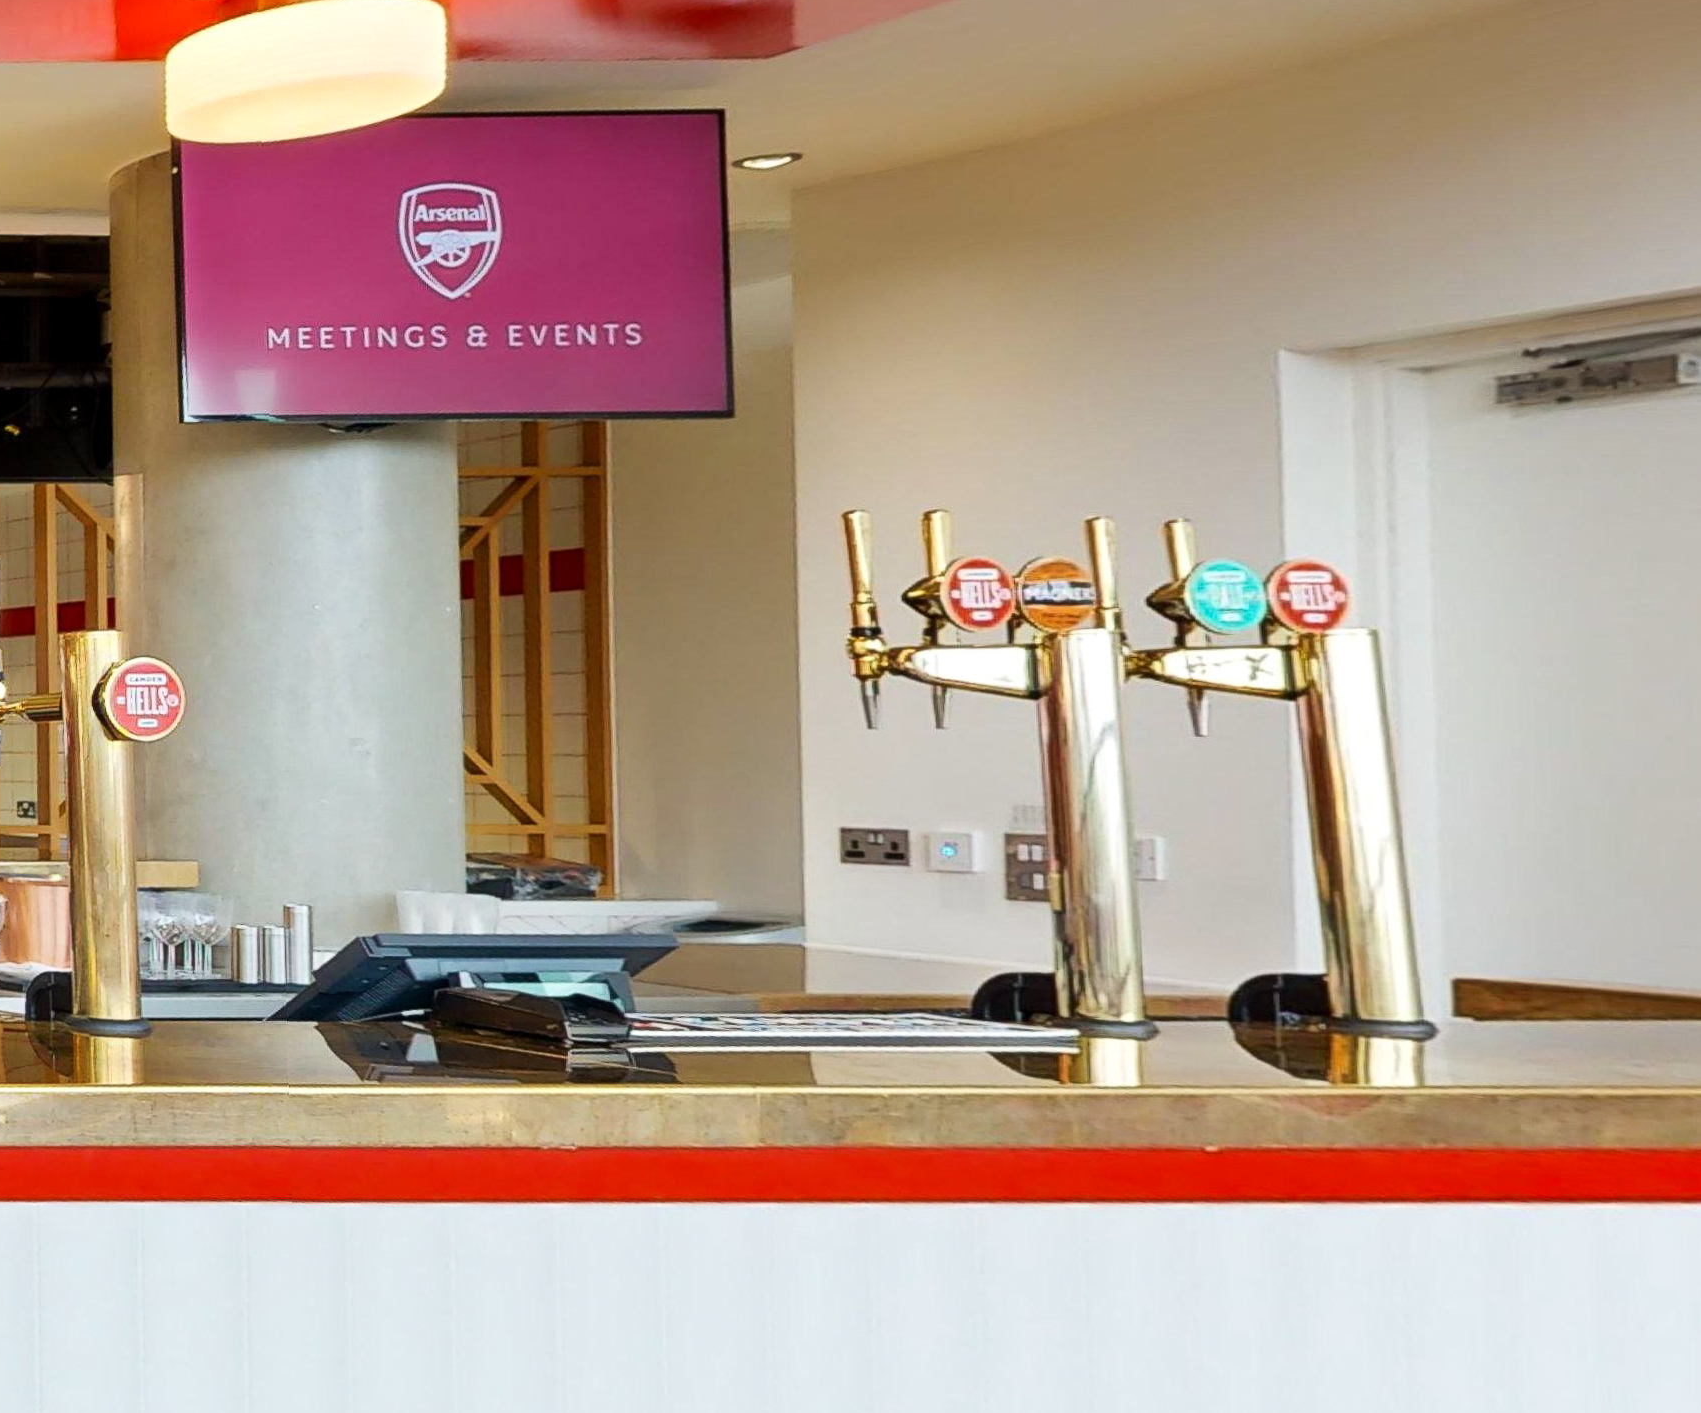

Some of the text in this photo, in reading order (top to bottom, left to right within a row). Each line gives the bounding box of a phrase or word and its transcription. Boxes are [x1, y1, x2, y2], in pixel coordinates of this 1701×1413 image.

[413, 203, 488, 223] Arsenal
[266, 323, 643, 350] MEETINGS & EVENTS
[126, 686, 169, 715] HELLS
